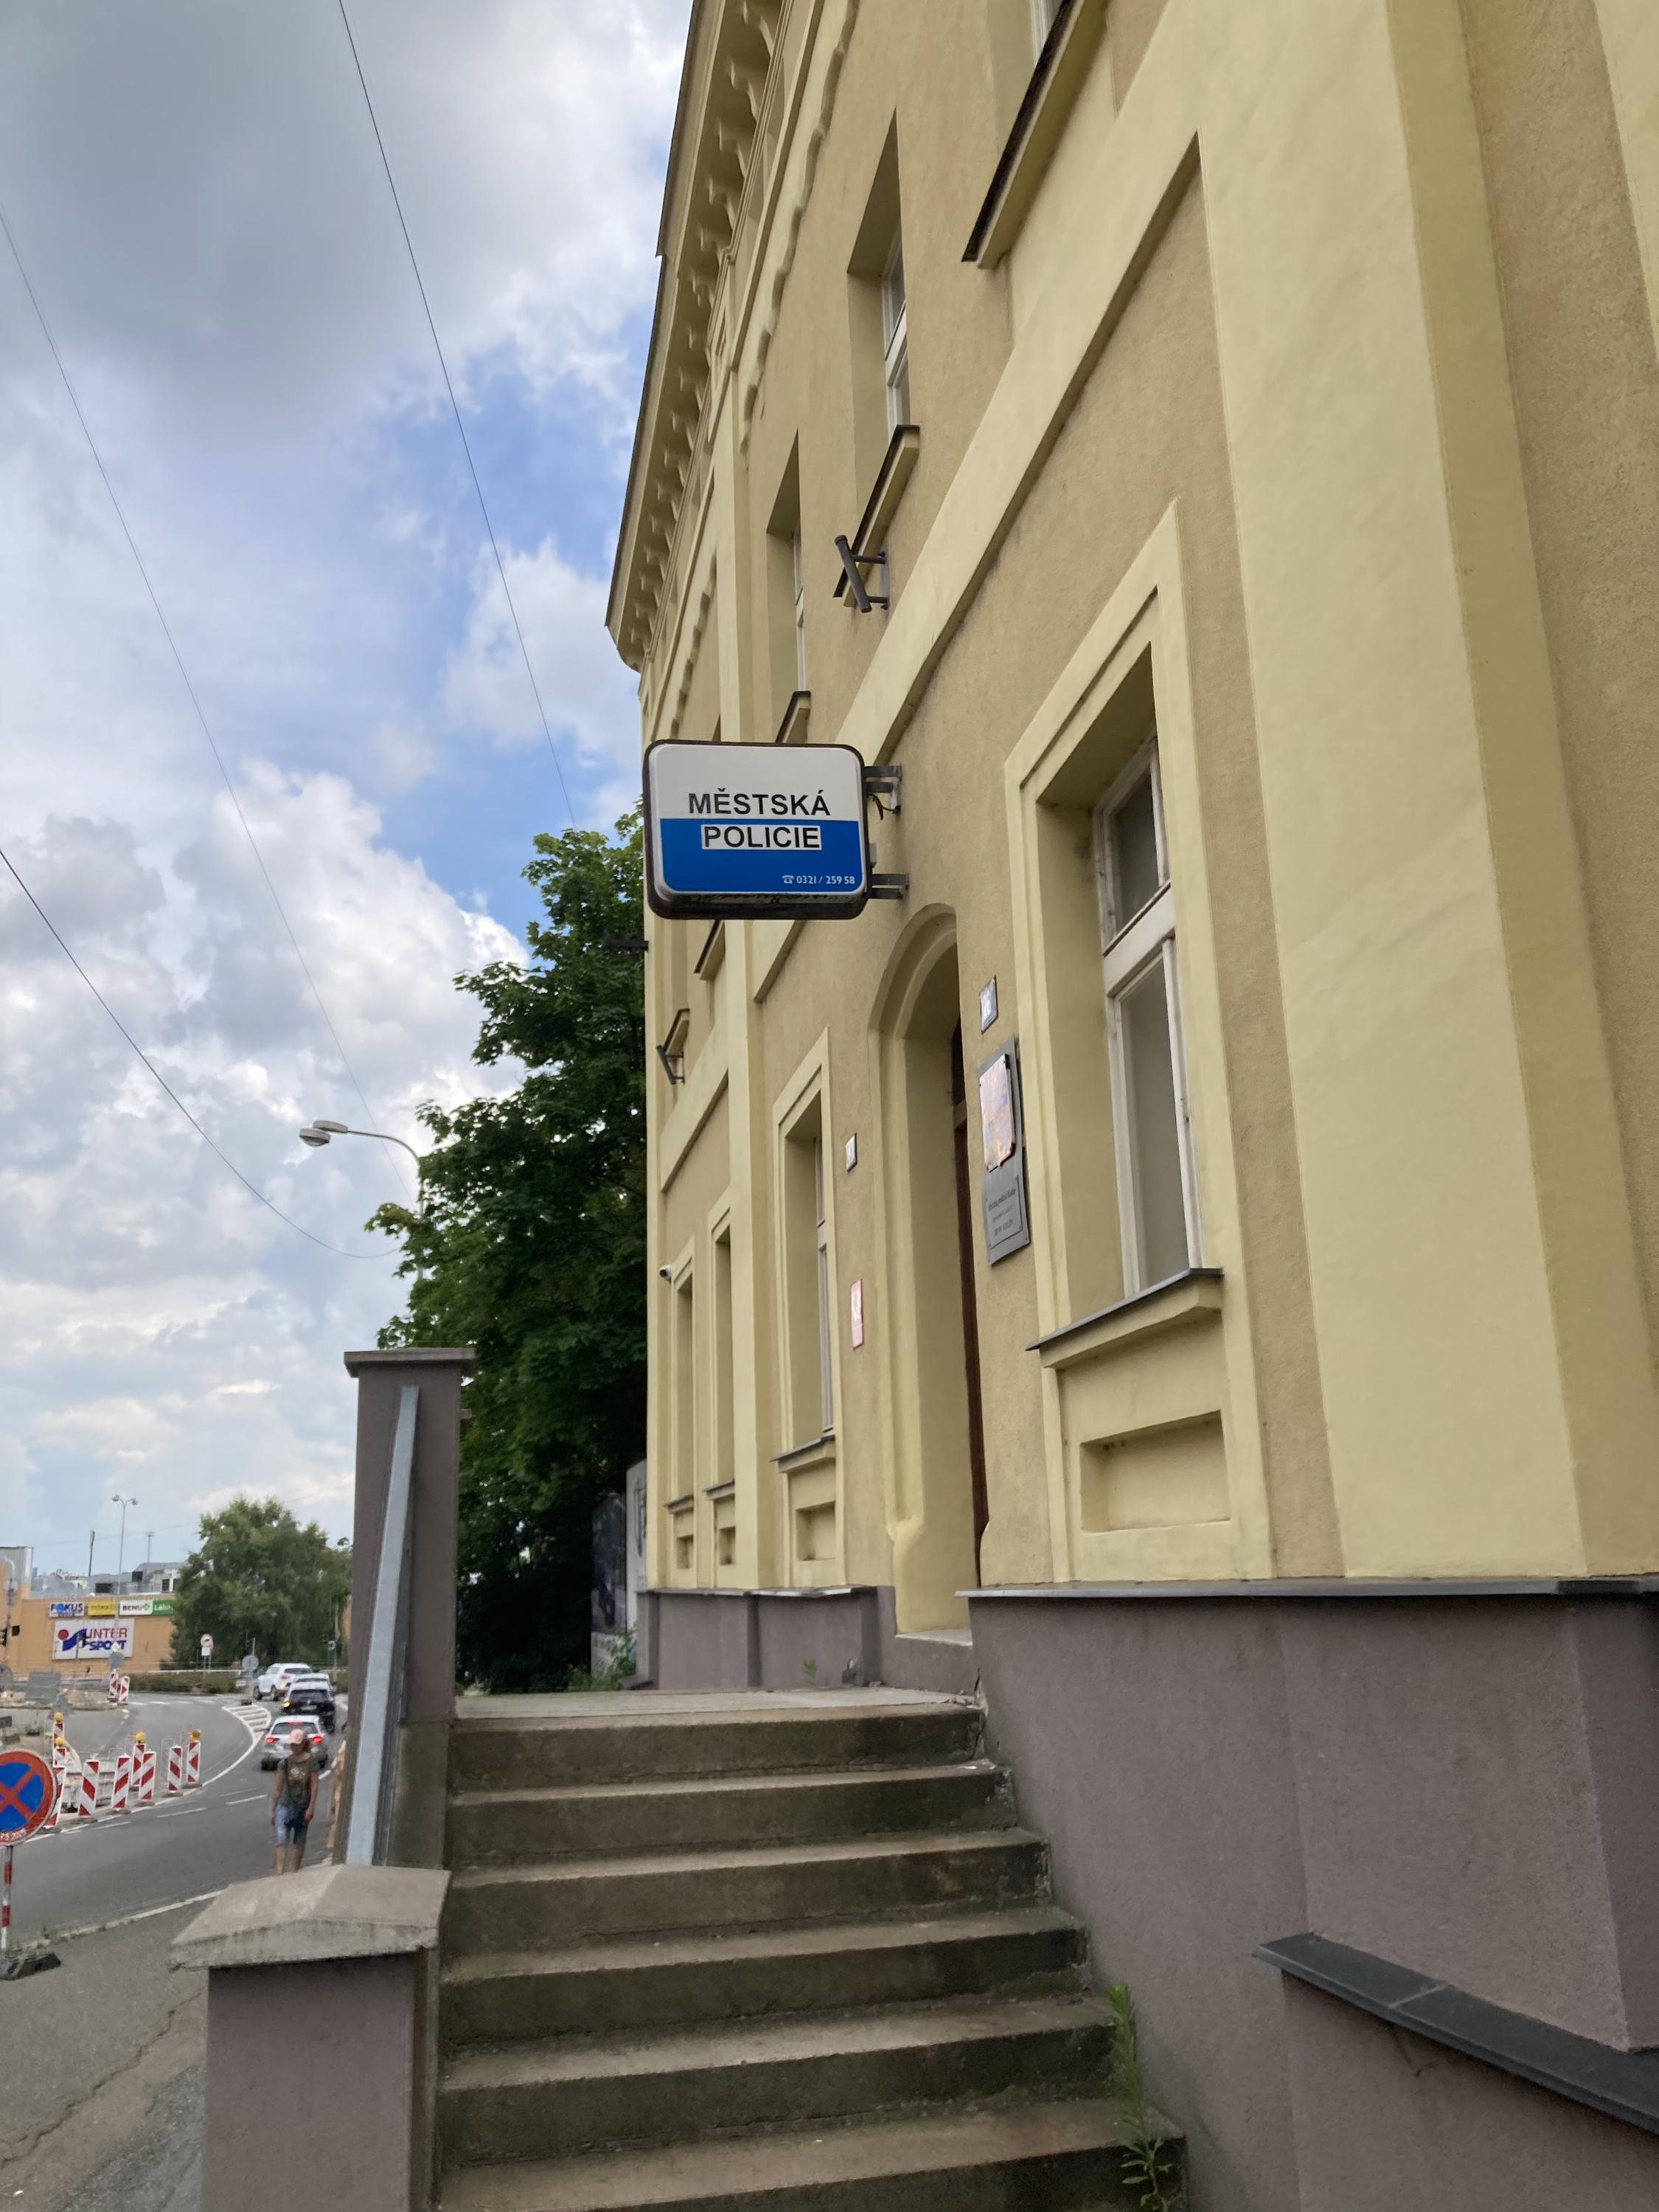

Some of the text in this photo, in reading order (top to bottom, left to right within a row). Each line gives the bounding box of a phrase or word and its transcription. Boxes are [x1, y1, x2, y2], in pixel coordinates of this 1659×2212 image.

[688, 787, 831, 815] MĚSTSKÁ
[703, 826, 820, 849] POLICIE
[89, 1640, 127, 1650] SPOT
